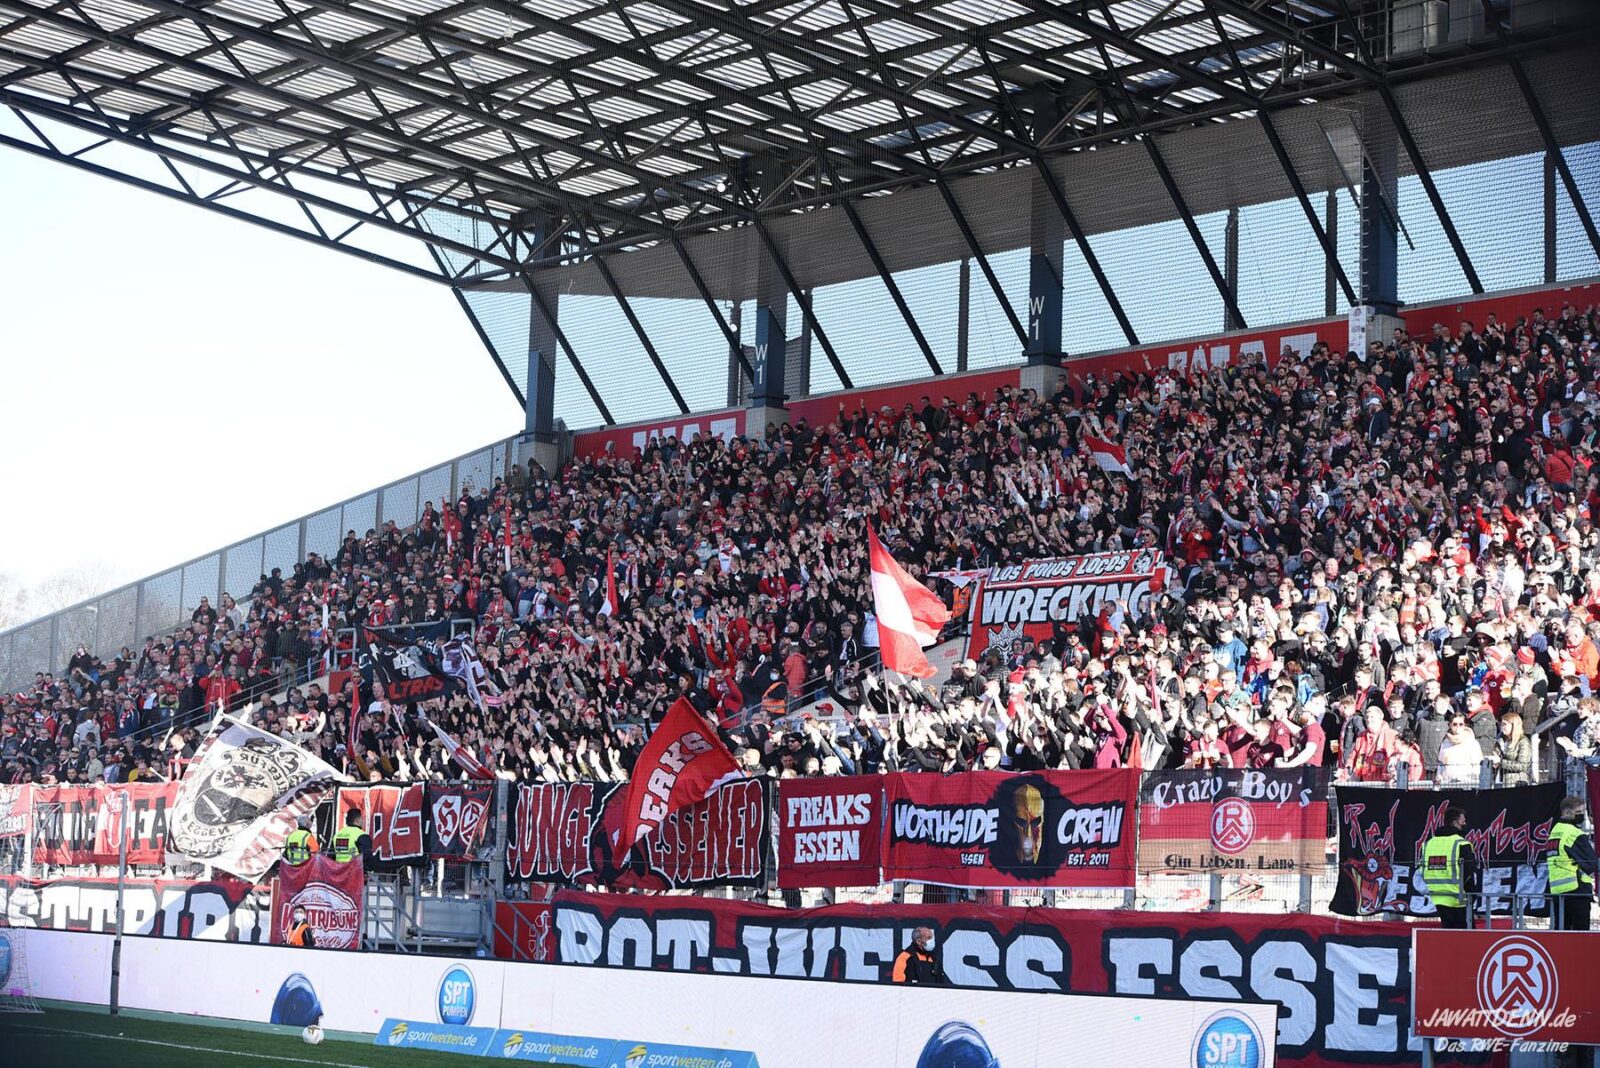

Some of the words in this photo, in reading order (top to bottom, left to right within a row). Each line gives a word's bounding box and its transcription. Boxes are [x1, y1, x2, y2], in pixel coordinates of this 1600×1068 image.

[991, 564, 1023, 582] LOS
[1076, 554, 1131, 576] LOCOS
[787, 793, 872, 828] FREAKS
[1057, 805, 1124, 846] CREW
[507, 782, 594, 880] JUNGE
[794, 830, 860, 864] ESSEN
[1344, 799, 1400, 862] Red
[1067, 853, 1087, 866] EST.
[1089, 852, 1110, 867] 2011
[1165, 854, 1191, 869] Ein
[1385, 863, 1550, 914] ESEN
[443, 980, 471, 1006] SPT
[1109, 937, 1424, 1053] ESSE
[407, 1029, 477, 1047] sportwetten.de
[523, 1041, 598, 1060] sportwetten.de
[1205, 1031, 1252, 1065] SPT
[647, 1052, 732, 1068] sportwetten.de
